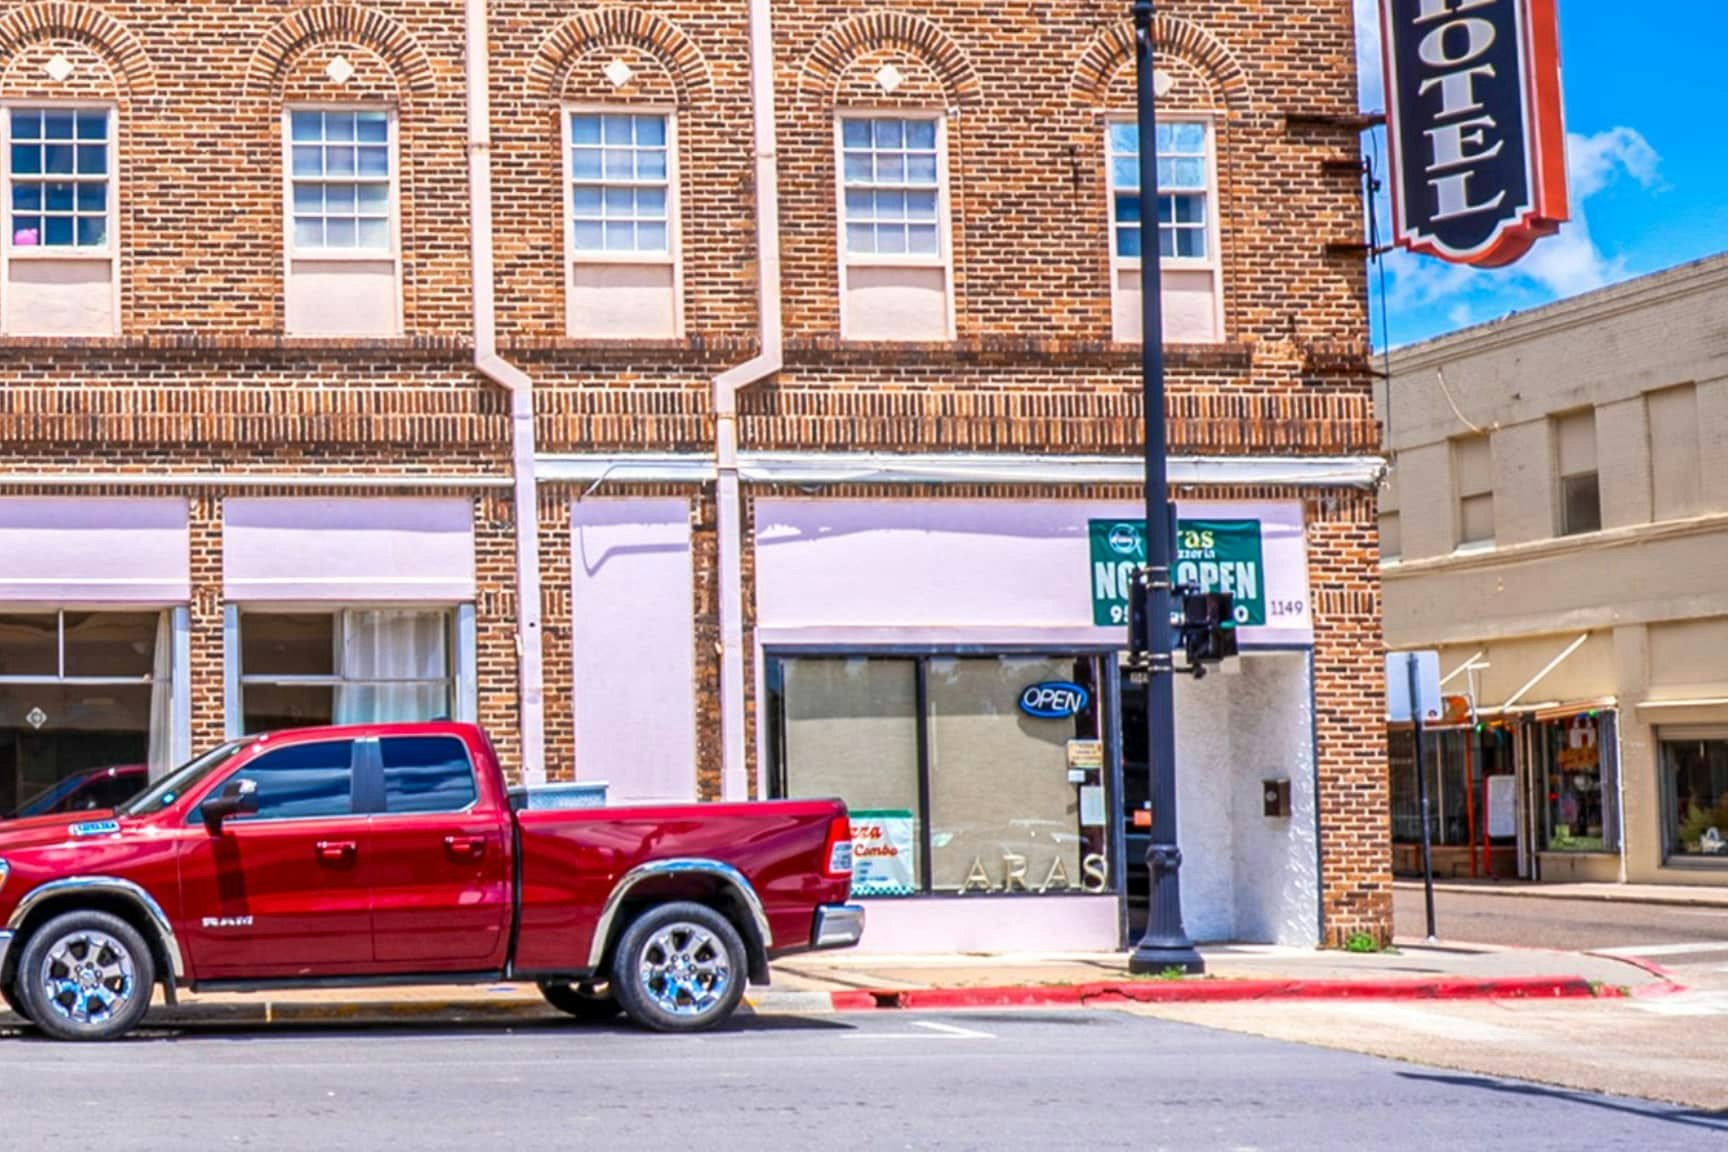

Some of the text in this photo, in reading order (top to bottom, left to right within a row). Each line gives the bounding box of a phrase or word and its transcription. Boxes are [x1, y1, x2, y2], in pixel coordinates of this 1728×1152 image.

[1176, 561, 1258, 600] OPEN
[1271, 600, 1304, 615] 1149
[1023, 687, 1082, 712] OPEN
[957, 853, 1109, 895] ARAS
[202, 915, 254, 928] RAM
